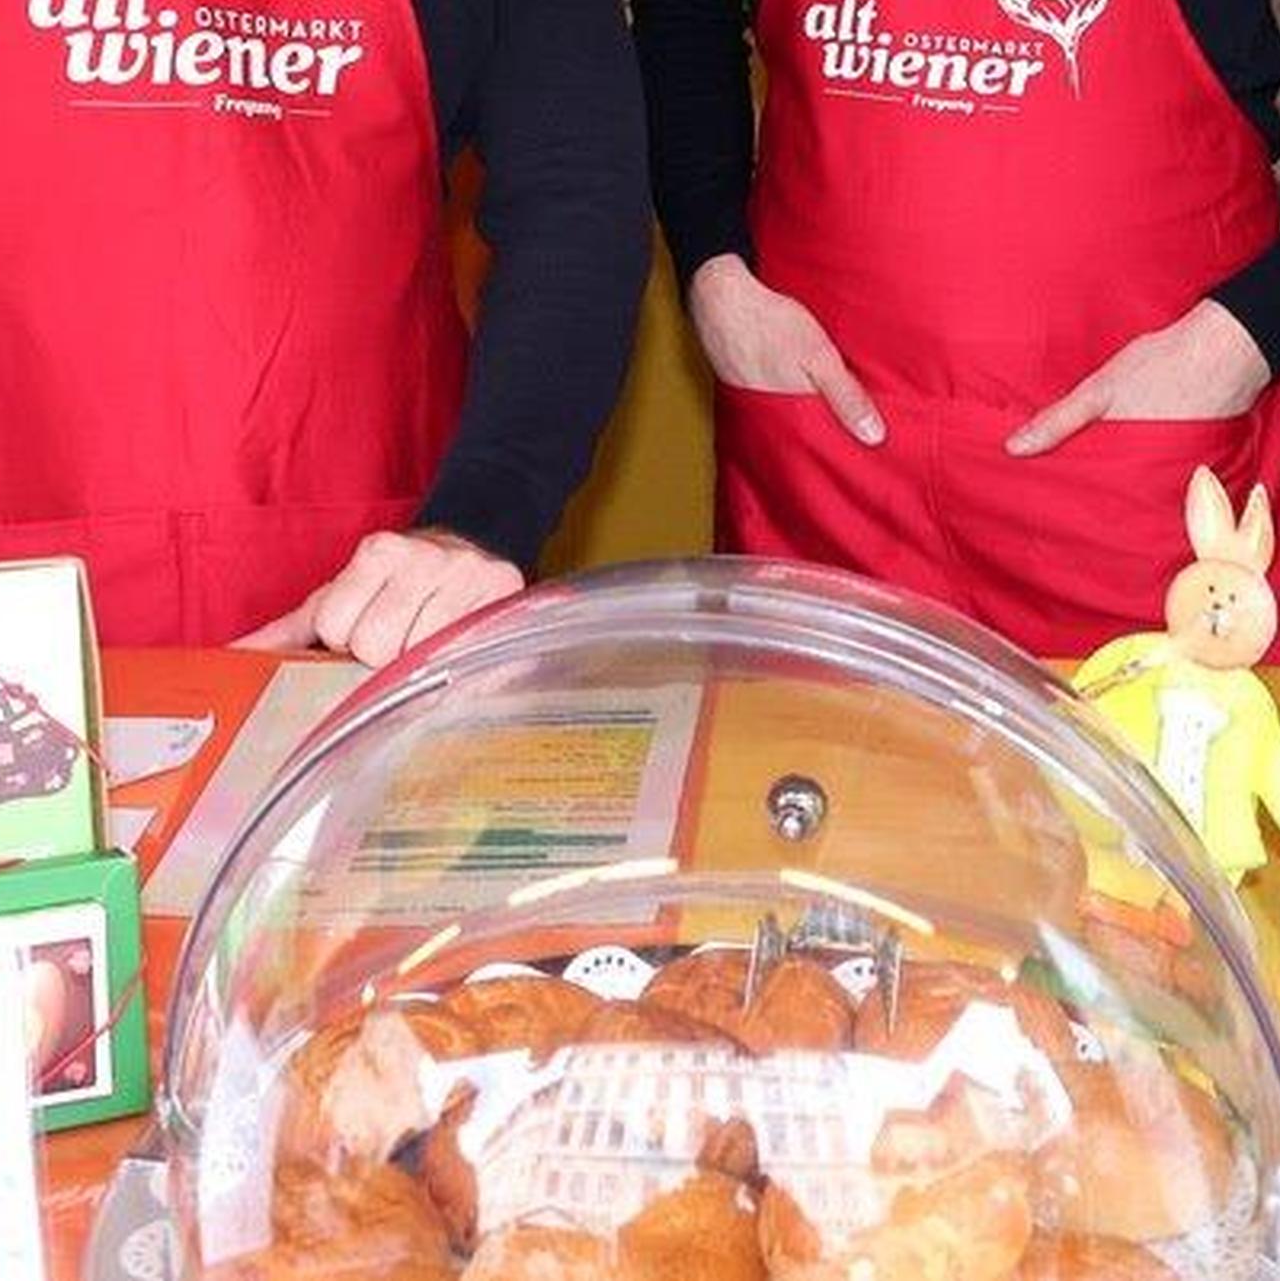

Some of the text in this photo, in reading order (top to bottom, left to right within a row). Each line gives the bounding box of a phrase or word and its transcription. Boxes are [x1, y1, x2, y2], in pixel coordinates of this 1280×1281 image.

[194, 6, 365, 40] OSTERMARKT
[66, 29, 364, 96] wiener
[904, 33, 1046, 58] OSTERMARKT
[822, 43, 1046, 96] wiener
